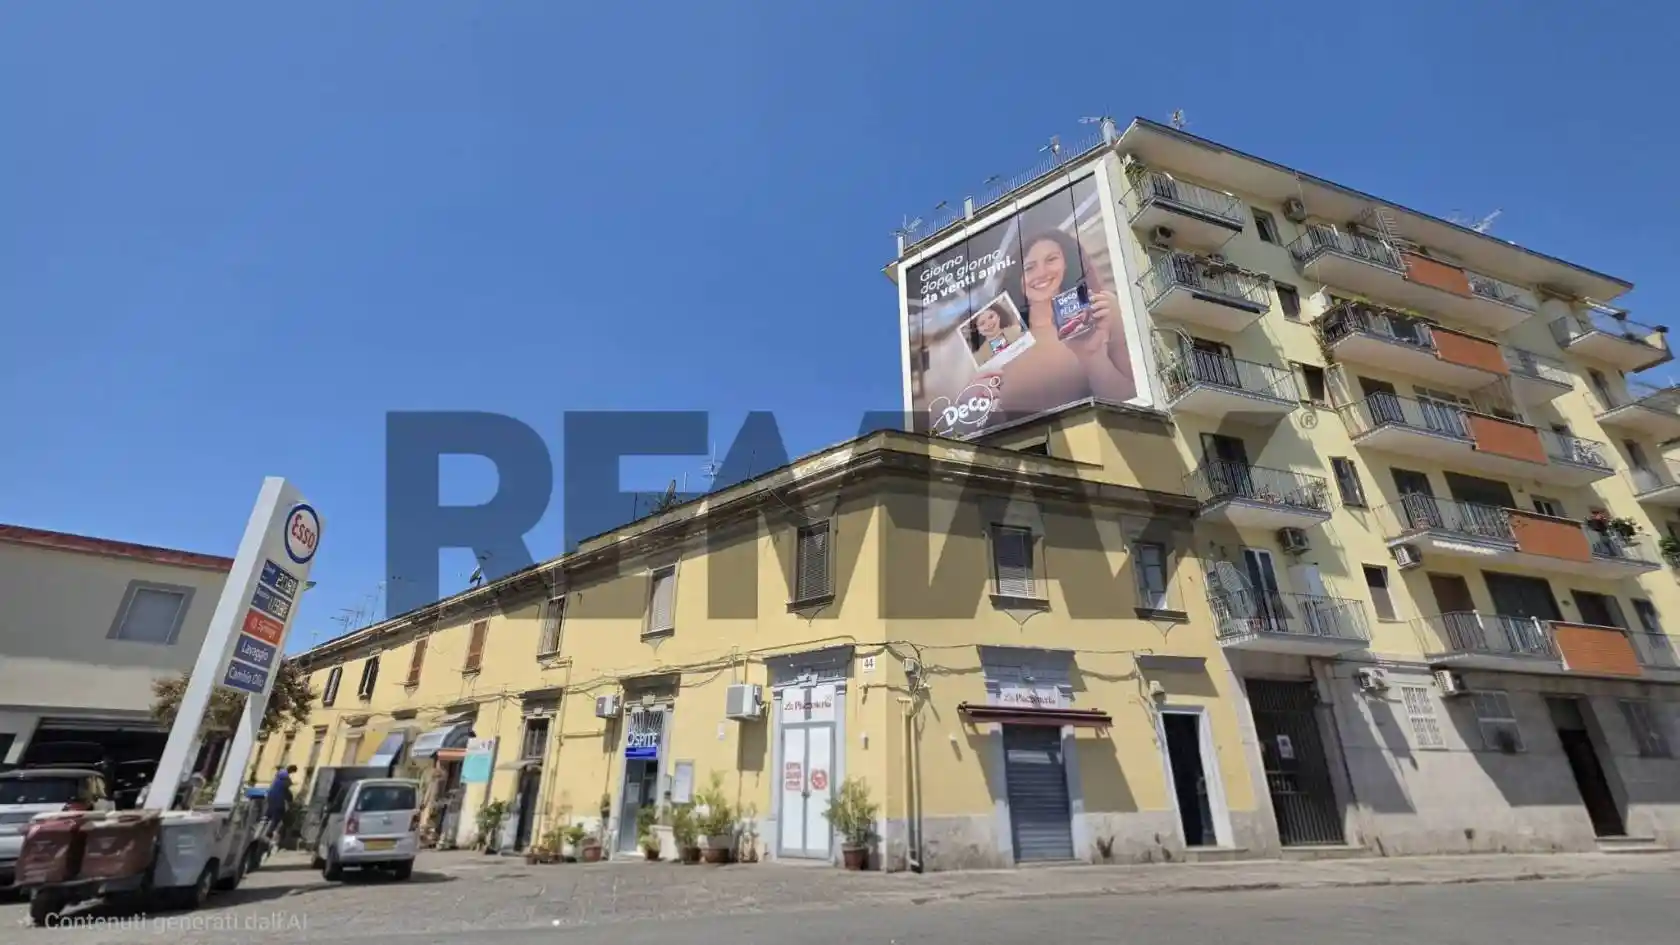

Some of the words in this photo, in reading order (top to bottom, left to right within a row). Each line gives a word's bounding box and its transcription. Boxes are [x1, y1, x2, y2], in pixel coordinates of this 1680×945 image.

[920, 256, 964, 281] Giorno
[920, 273, 954, 295] dopo
[956, 249, 1001, 279] giorno
[922, 292, 938, 306] da
[940, 272, 975, 297] venti
[978, 255, 1016, 280] anni.
[241, 639, 269, 662] Lavaggio
[863, 658, 874, 668] 44
